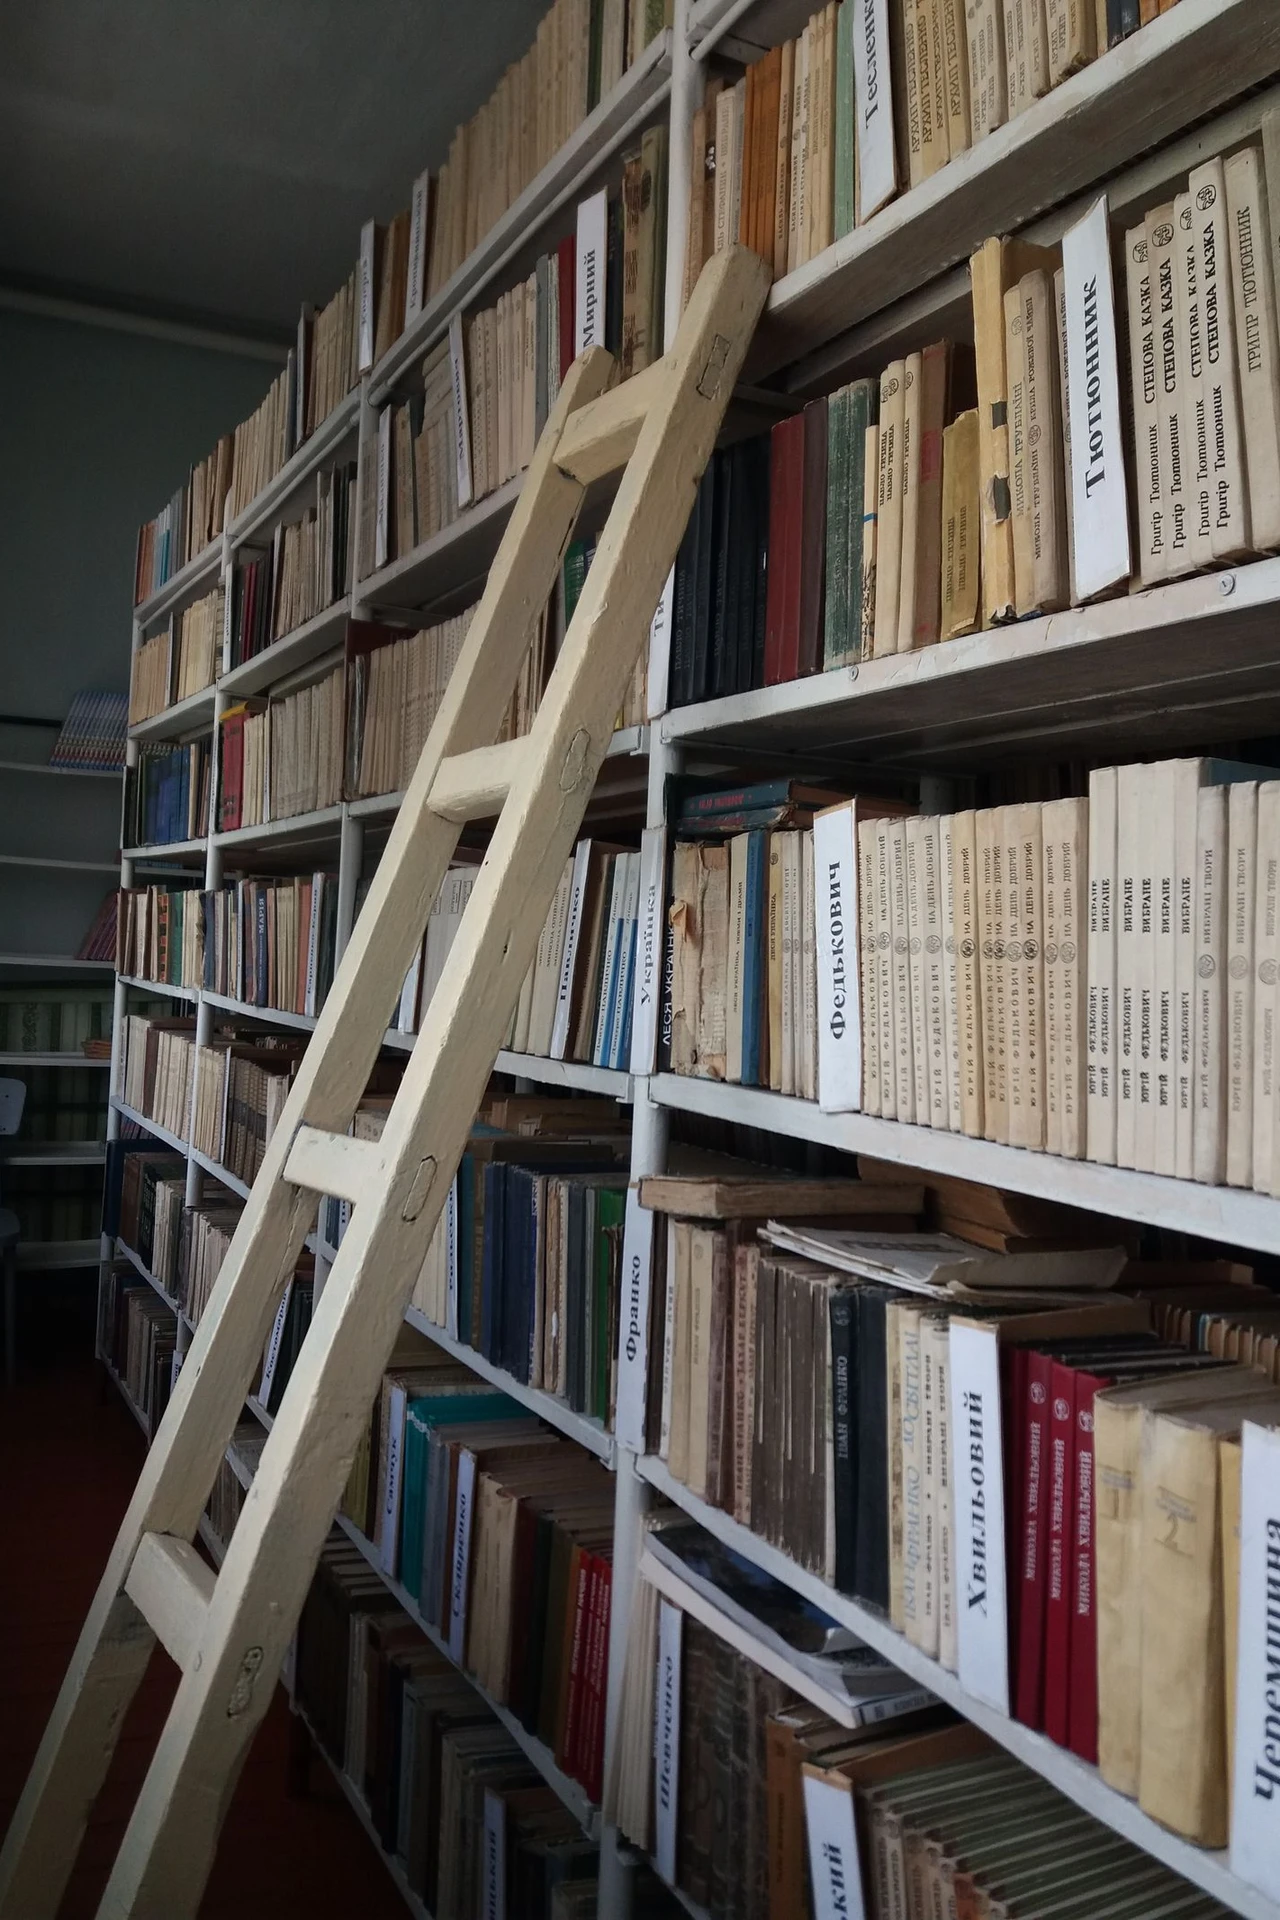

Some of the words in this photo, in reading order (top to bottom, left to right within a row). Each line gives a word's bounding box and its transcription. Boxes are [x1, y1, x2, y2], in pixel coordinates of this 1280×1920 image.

[905, 22, 917, 103] ТЕСЛЕНКО
[917, 14, 930, 94] ТЕСЛЕНКО
[921, 93, 932, 144] АРХИП
[948, 64, 961, 117] АРХИП
[909, 102, 920, 154] АРХИП
[1202, 221, 1217, 280] КАЗКА
[1236, 206, 1257, 309] ТЮТЮННИК
[583, 248, 598, 350] Мирний
[1140, 276, 1153, 327] КАЗКА
[1159, 257, 1174, 314] КАЗКА
[1205, 283, 1221, 366] СТЕПОВА
[1244, 314, 1262, 373] ГРИГІР
[1142, 331, 1156, 405] СТЕПОВА
[1162, 318, 1177, 395] СТЕПОВА
[1082, 273, 1107, 500] Тютюнник
[1010, 381, 1024, 456] ТРУБЛАЇНІ
[1194, 399, 1208, 483] Тютюнник
[1211, 386, 1226, 472] Тютюнник
[1147, 424, 1161, 502] Тютюнник
[1168, 414, 1183, 496] Тютюнник
[1013, 458, 1026, 518] МИКОЛА
[1197, 491, 1210, 538] Григір
[1214, 480, 1230, 529] Григір
[1150, 511, 1164, 556] Григір
[1171, 504, 1186, 550] Григір
[865, 853, 874, 888] ДОБРИЙ
[877, 835, 887, 877] ДОБРИЙ
[893, 839, 903, 881] ДОБРИЙ
[924, 834, 934, 879] ДОБРИЙ
[960, 847, 970, 885] ДОБРИЙ
[992, 845, 1002, 884] ДОБРИЙ
[1008, 846, 1017, 885] ДОБРИЙ
[1023, 841, 1034, 882] ДОБРИЙ
[1061, 841, 1071, 882] ДОБРИЙ
[1204, 849, 1214, 889] ТВОРИ
[1236, 848, 1247, 888] ТВОРИ
[1266, 859, 1277, 892] ТВОРИ
[926, 880, 936, 910] ДЕНЬ
[927, 911, 936, 924] НА
[963, 889, 971, 916] ДЕНЬ
[994, 889, 1003, 916] ДЕНЬ
[1009, 889, 1018, 918] ДЕНЬ
[1025, 887, 1034, 915] ДЕНЬ
[1063, 888, 1072, 917] ДЕНЬ
[1101, 878, 1111, 932] ВИБРАНЕ
[1123, 877, 1134, 932] ВИБРАНЕ
[1141, 877, 1152, 934] ВИБРАНЕ
[1160, 877, 1172, 934] ВИБРАНЕ
[1181, 877, 1192, 935] ВИБРАНЕ
[1203, 892, 1213, 945] ВИБРАНІ
[1235, 892, 1246, 945] ВИБРАНІ
[1265, 895, 1276, 937] ВИБРАНІ
[559, 886, 581, 1002] Павличко
[640, 884, 656, 1007] Українка
[828, 860, 847, 1041] Федькович
[964, 921, 971, 935] НА
[994, 921, 1003, 936] НА
[1010, 923, 1018, 938] НА
[1026, 920, 1035, 935] НА
[1063, 922, 1071, 938] НА
[601, 948, 613, 1013] ПАВЛИЧКО
[616, 950, 627, 1015] ПАВЛИЧКО
[868, 958, 876, 1038] ФЕДЬКОВИЧ
[881, 959, 890, 1050] ФЕДЬКОВИЧ
[965, 963, 973, 1052] ФЕДЬКОВИЧ
[662, 1002, 673, 1046] ЛЕСЯ
[898, 964, 908, 1057] ФЕДЬКОВИЧ
[930, 964, 941, 1059] ФЕДЬКОВИЧ
[1011, 967, 1020, 1060] ФЕДЬКОВИЧ
[1027, 965, 1036, 1060] ФЕДЬКОВИЧ
[1088, 986, 1098, 1054] ФЕДЬКОВИЧ
[1100, 987, 1110, 1055] ФЕДЬКОВИЧ
[1122, 987, 1133, 1057] ФЕДЬКОВИЧ
[1141, 989, 1151, 1060] ФЕДЬКОВИЧ
[1159, 990, 1171, 1062] ФЕДЬКОВИЧ
[1179, 992, 1191, 1065] ФЕДЬКОВИЧ
[1201, 989, 1211, 1069] ФЕДЬКОВИЧ
[1232, 990, 1244, 1071] ФЕДЬКОВИЧ
[933, 1069, 942, 1109] ЮРІЙ
[1087, 1064, 1096, 1095] ЮРІЙ
[1100, 1067, 1109, 1098] ЮРІЙ
[1121, 1067, 1132, 1100] ЮРІЙ
[1139, 1071, 1151, 1104] ЮРІЙ
[1157, 1073, 1170, 1107] ЮРІЙ
[1178, 1076, 1190, 1110] ЮРІЙ
[1200, 1073, 1210, 1109] ЮРІЙ
[1231, 1076, 1242, 1112] ЮРІЙ
[625, 1254, 641, 1363] Франко
[836, 1355, 848, 1416] ФРАНКО
[836, 1422, 849, 1459] ІВАН
[1026, 1421, 1041, 1516] ХВИЛЬОВИЙ
[386, 1436, 398, 1515] Самчук
[1051, 1438, 1066, 1534] ХВИЛЬОВИЙ
[1077, 1450, 1093, 1548] ХВИЛЬОВИЙ
[962, 1390, 988, 1619] Хвильовий
[1024, 1520, 1038, 1582] МИКОЛА
[1050, 1538, 1063, 1601] МИКОЛА
[1076, 1552, 1092, 1617] МИКОЛА
[660, 1654, 673, 1812] Шевченко
